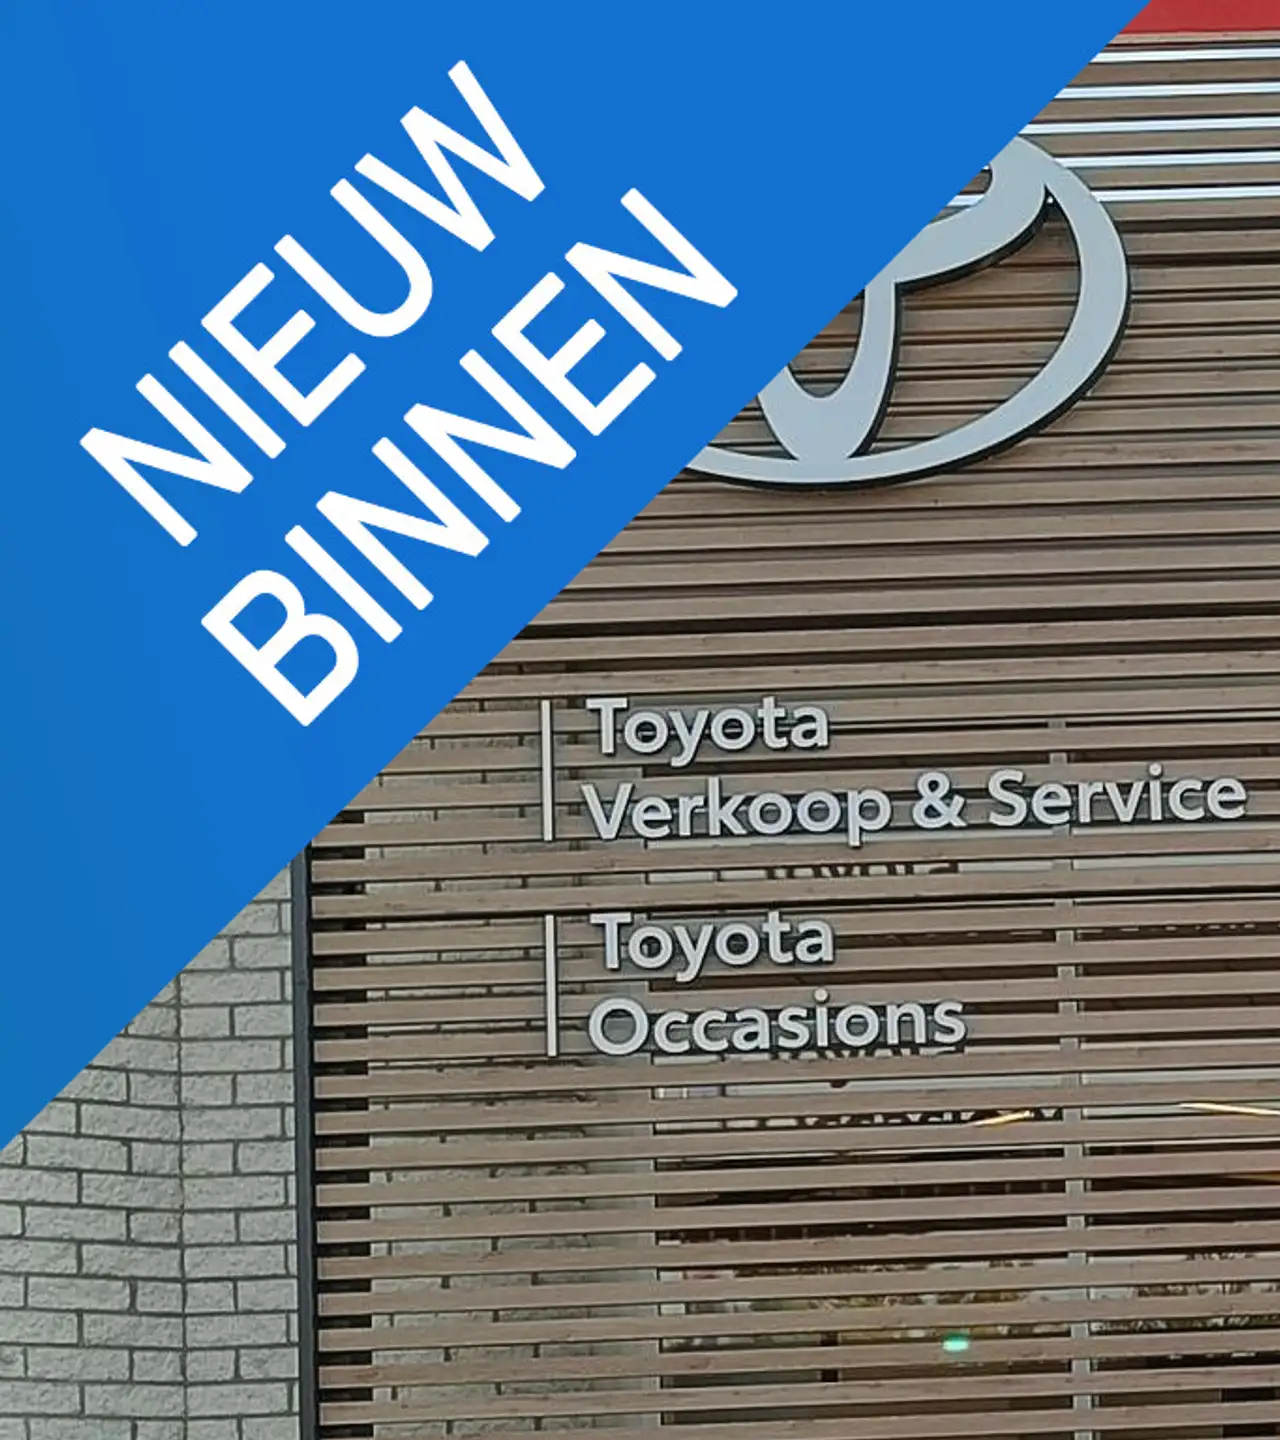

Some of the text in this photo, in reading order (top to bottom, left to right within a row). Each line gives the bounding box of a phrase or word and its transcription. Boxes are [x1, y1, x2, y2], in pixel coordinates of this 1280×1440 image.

[586, 697, 830, 767] Toyota
[582, 763, 1247, 846] Verkoop & Service
[590, 911, 834, 982] Toyota
[588, 989, 967, 1056] Occasions
